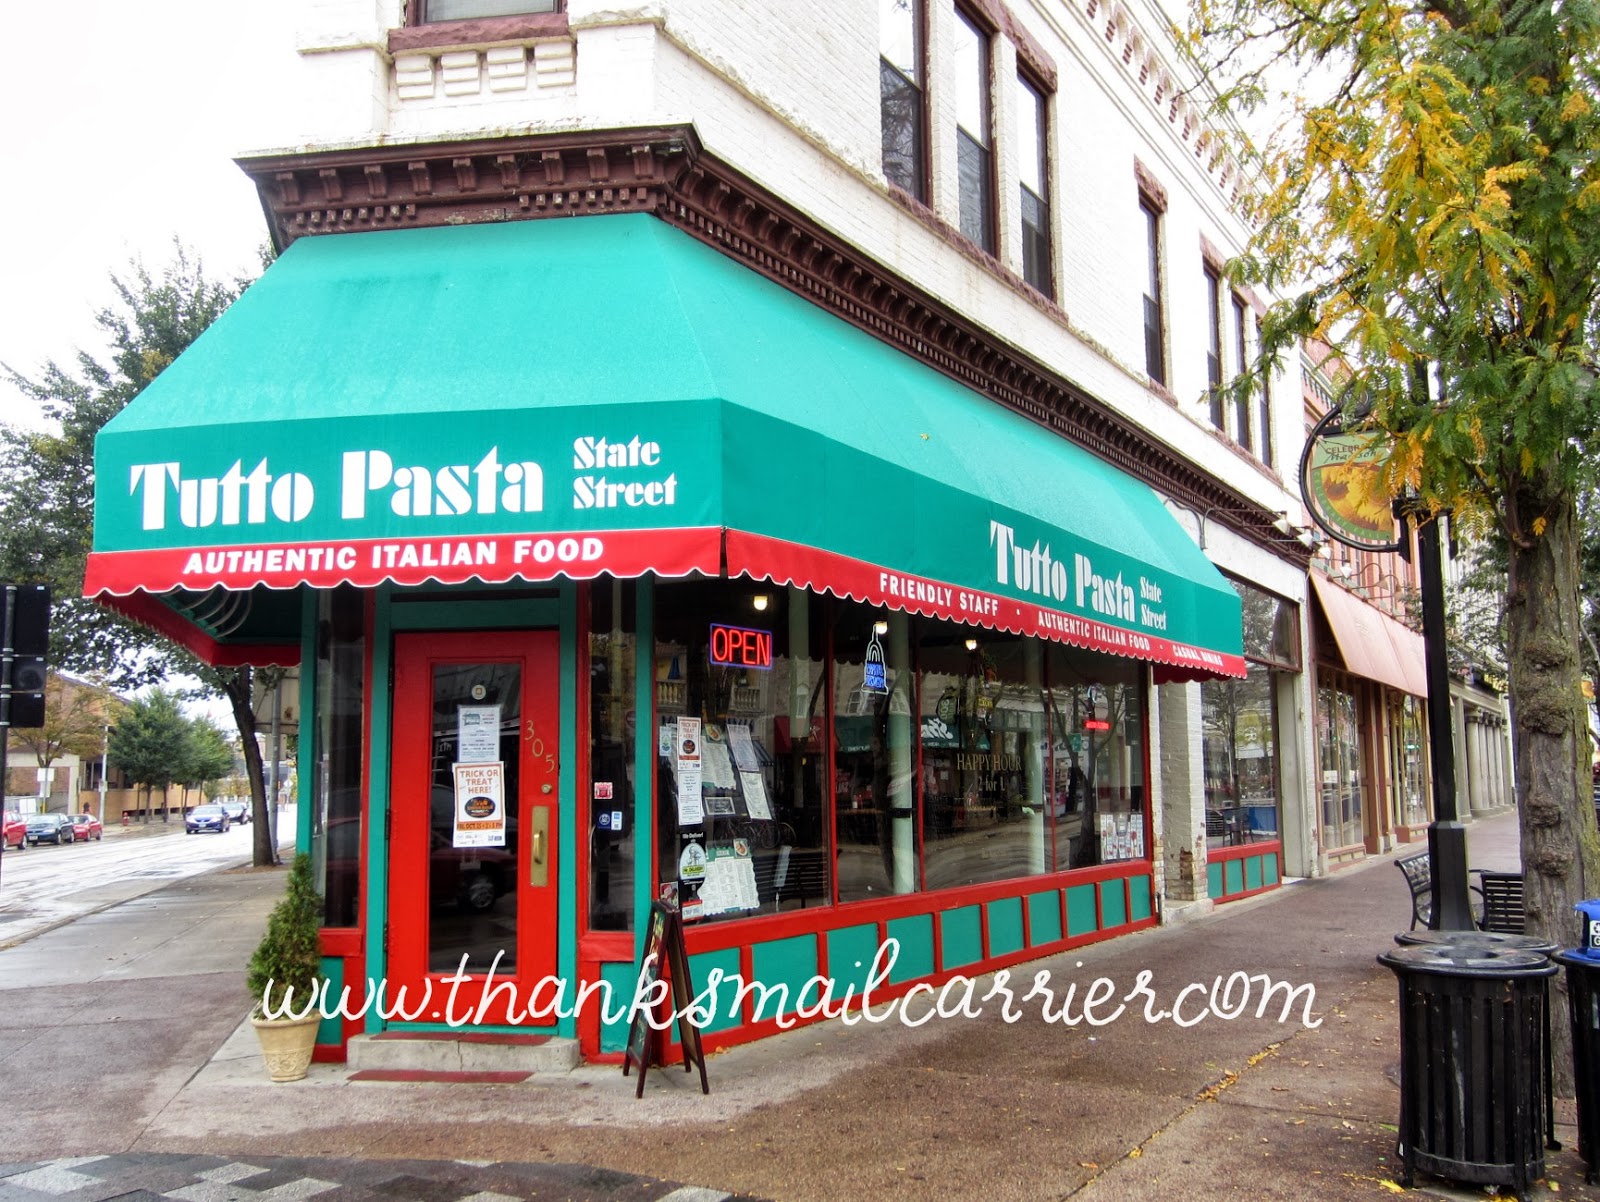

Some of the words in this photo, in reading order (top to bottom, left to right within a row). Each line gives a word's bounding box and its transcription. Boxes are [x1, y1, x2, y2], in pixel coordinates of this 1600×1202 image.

[573, 434, 661, 469] State
[129, 456, 315, 531] Tutto
[341, 445, 544, 520] Pasta
[573, 472, 678, 509] Street
[183, 547, 357, 575] AUTHENTIC
[371, 541, 497, 569] ITALIAN
[513, 537, 604, 564] FOOD
[990, 519, 1067, 602] Tutto
[1075, 552, 1135, 622] Pasta
[880, 572, 952, 607] FRIENDLY
[959, 592, 998, 616] STAFF
[1140, 576, 1162, 604] State
[1038, 610, 1090, 638] AUTHENTIC
[1093, 624, 1127, 646] ITALIAN
[1128, 633, 1151, 651] FOOD
[1141, 603, 1167, 630] Street
[712, 628, 770, 665] OPEN
[1172, 644, 1201, 660] CASUAL
[460, 770, 484, 778] TRICK
[486, 769, 499, 777] OR
[957, 753, 991, 771] HAPPY
[993, 754, 1022, 771] HOUR
[466, 778, 493, 786] TREAT
[467, 786, 492, 794] HERE!
